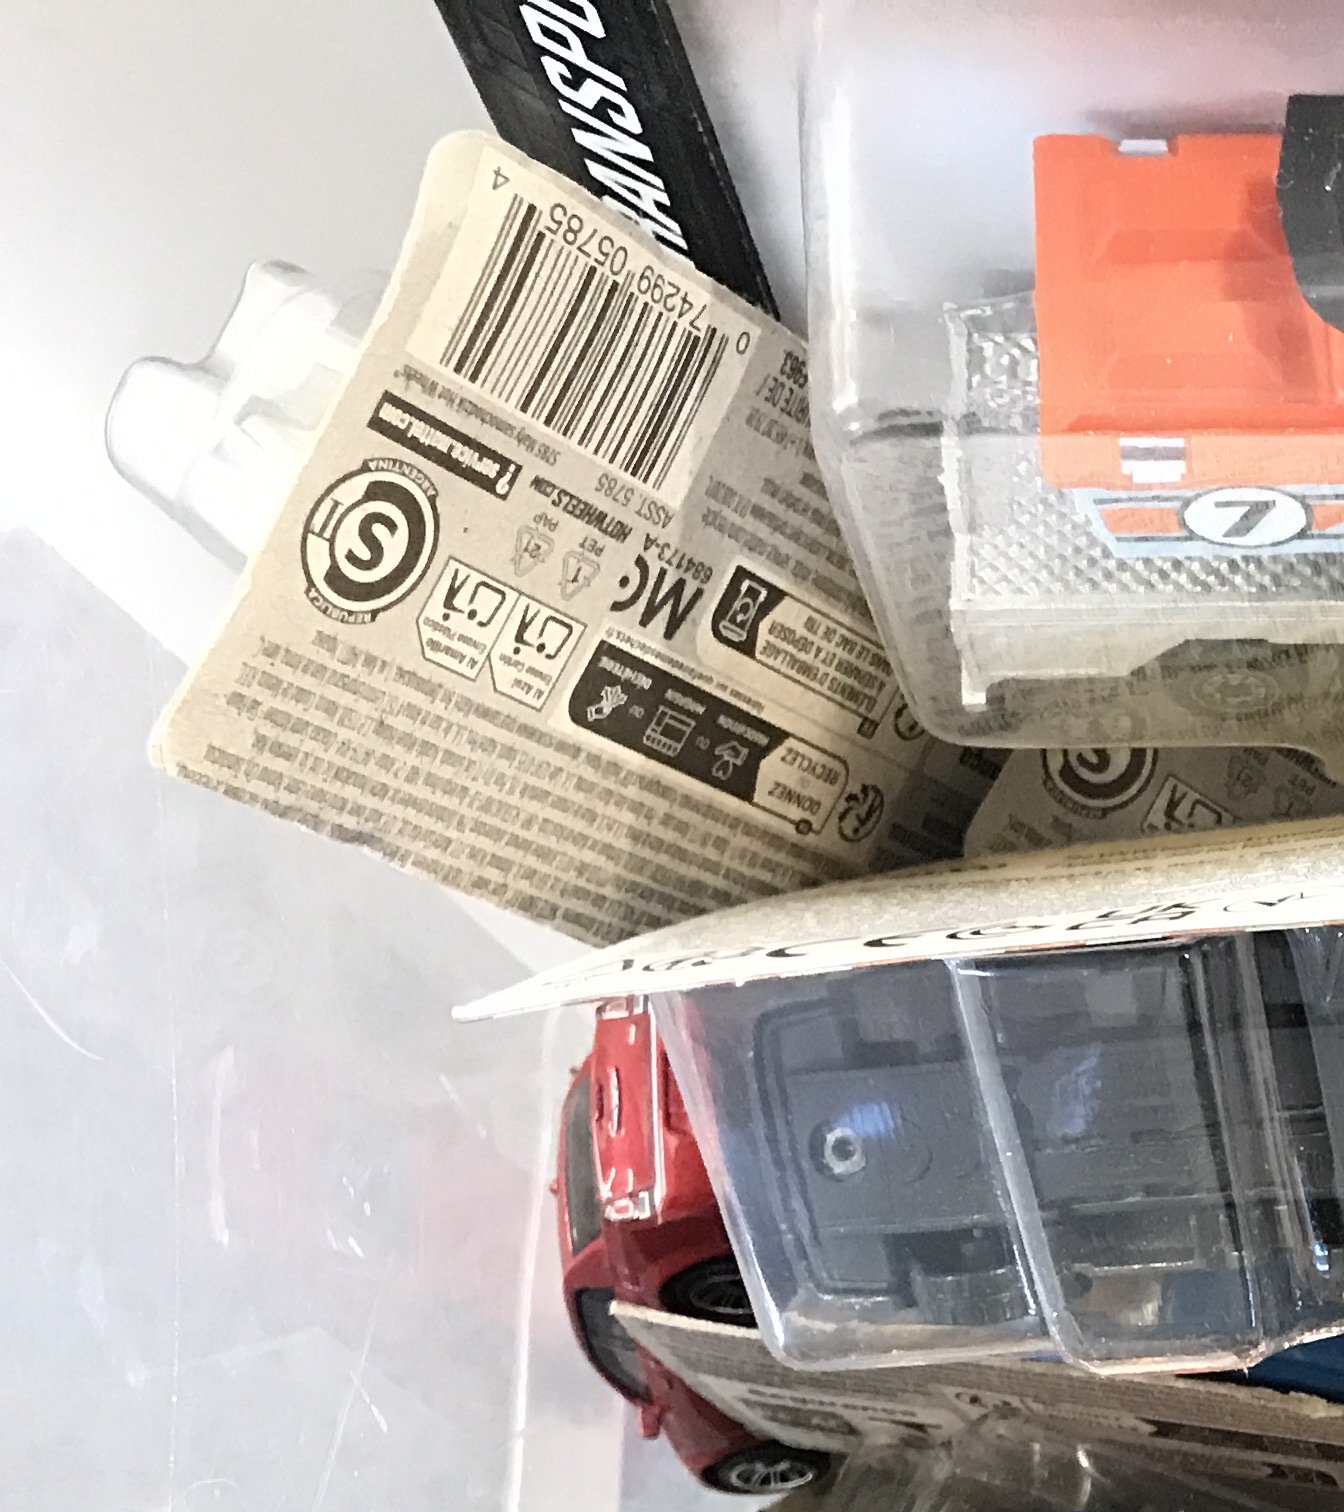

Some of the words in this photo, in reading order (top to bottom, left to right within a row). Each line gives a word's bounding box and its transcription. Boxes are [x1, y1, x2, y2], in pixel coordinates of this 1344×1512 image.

[483, 164, 513, 195] 4
[537, 199, 635, 277] 05785
[631, 263, 714, 331] 74299
[731, 329, 754, 355] 0
[376, 395, 501, 486] service.mattel.com
[592, 470, 636, 508] 5785
[531, 508, 560, 532] PAP
[629, 492, 675, 531] ASST.
[577, 533, 606, 558] PET
[779, 745, 842, 786] RECYCLEZ
[767, 780, 822, 817] DONNEZ
